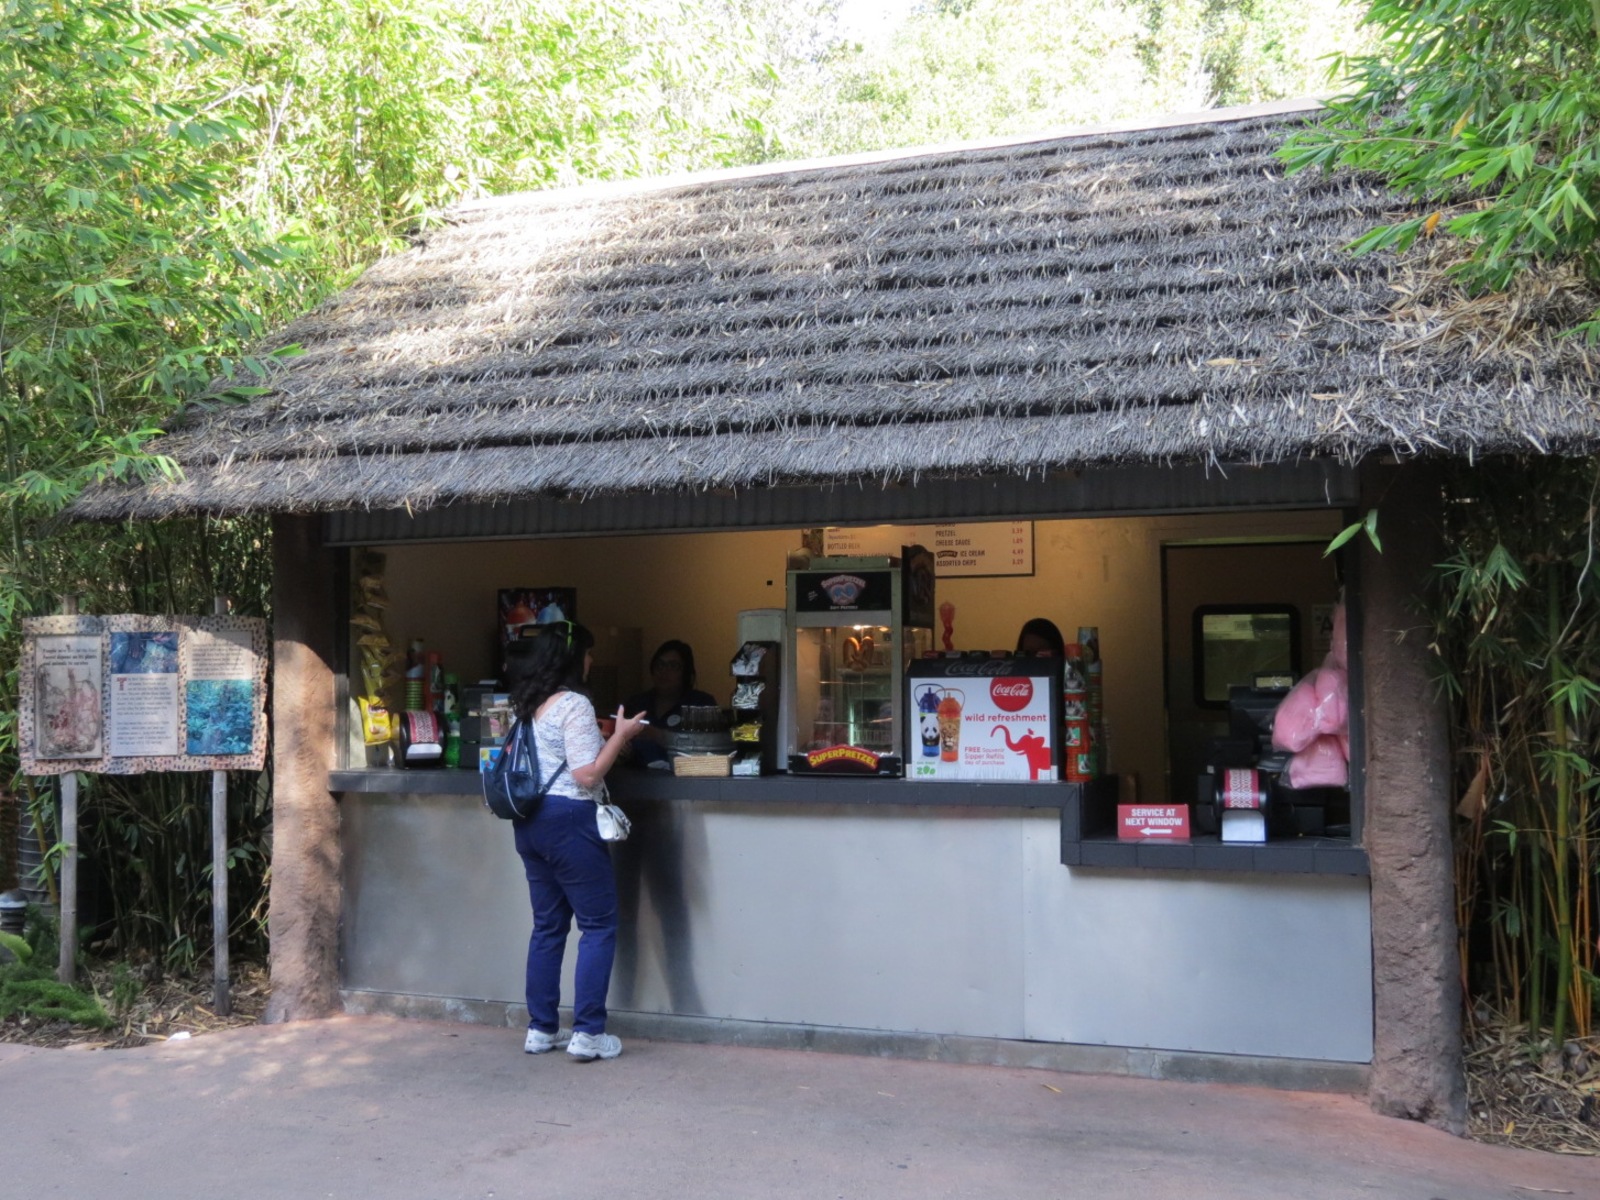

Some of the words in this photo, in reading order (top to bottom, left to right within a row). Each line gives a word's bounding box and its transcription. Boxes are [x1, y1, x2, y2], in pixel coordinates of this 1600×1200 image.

[969, 549, 985, 557] CREAM
[945, 660, 1015, 676] Coca-Cola
[992, 683, 1030, 697] Coca-Cola
[965, 713, 985, 722] wild
[988, 713, 1047, 722] refreshment
[809, 748, 877, 769] SUPERPRETZEL
[1131, 808, 1164, 817] SERVICE
[1166, 808, 1176, 817] AT
[1125, 817, 1146, 826] NEXT
[1147, 817, 1183, 826] WINDOW
